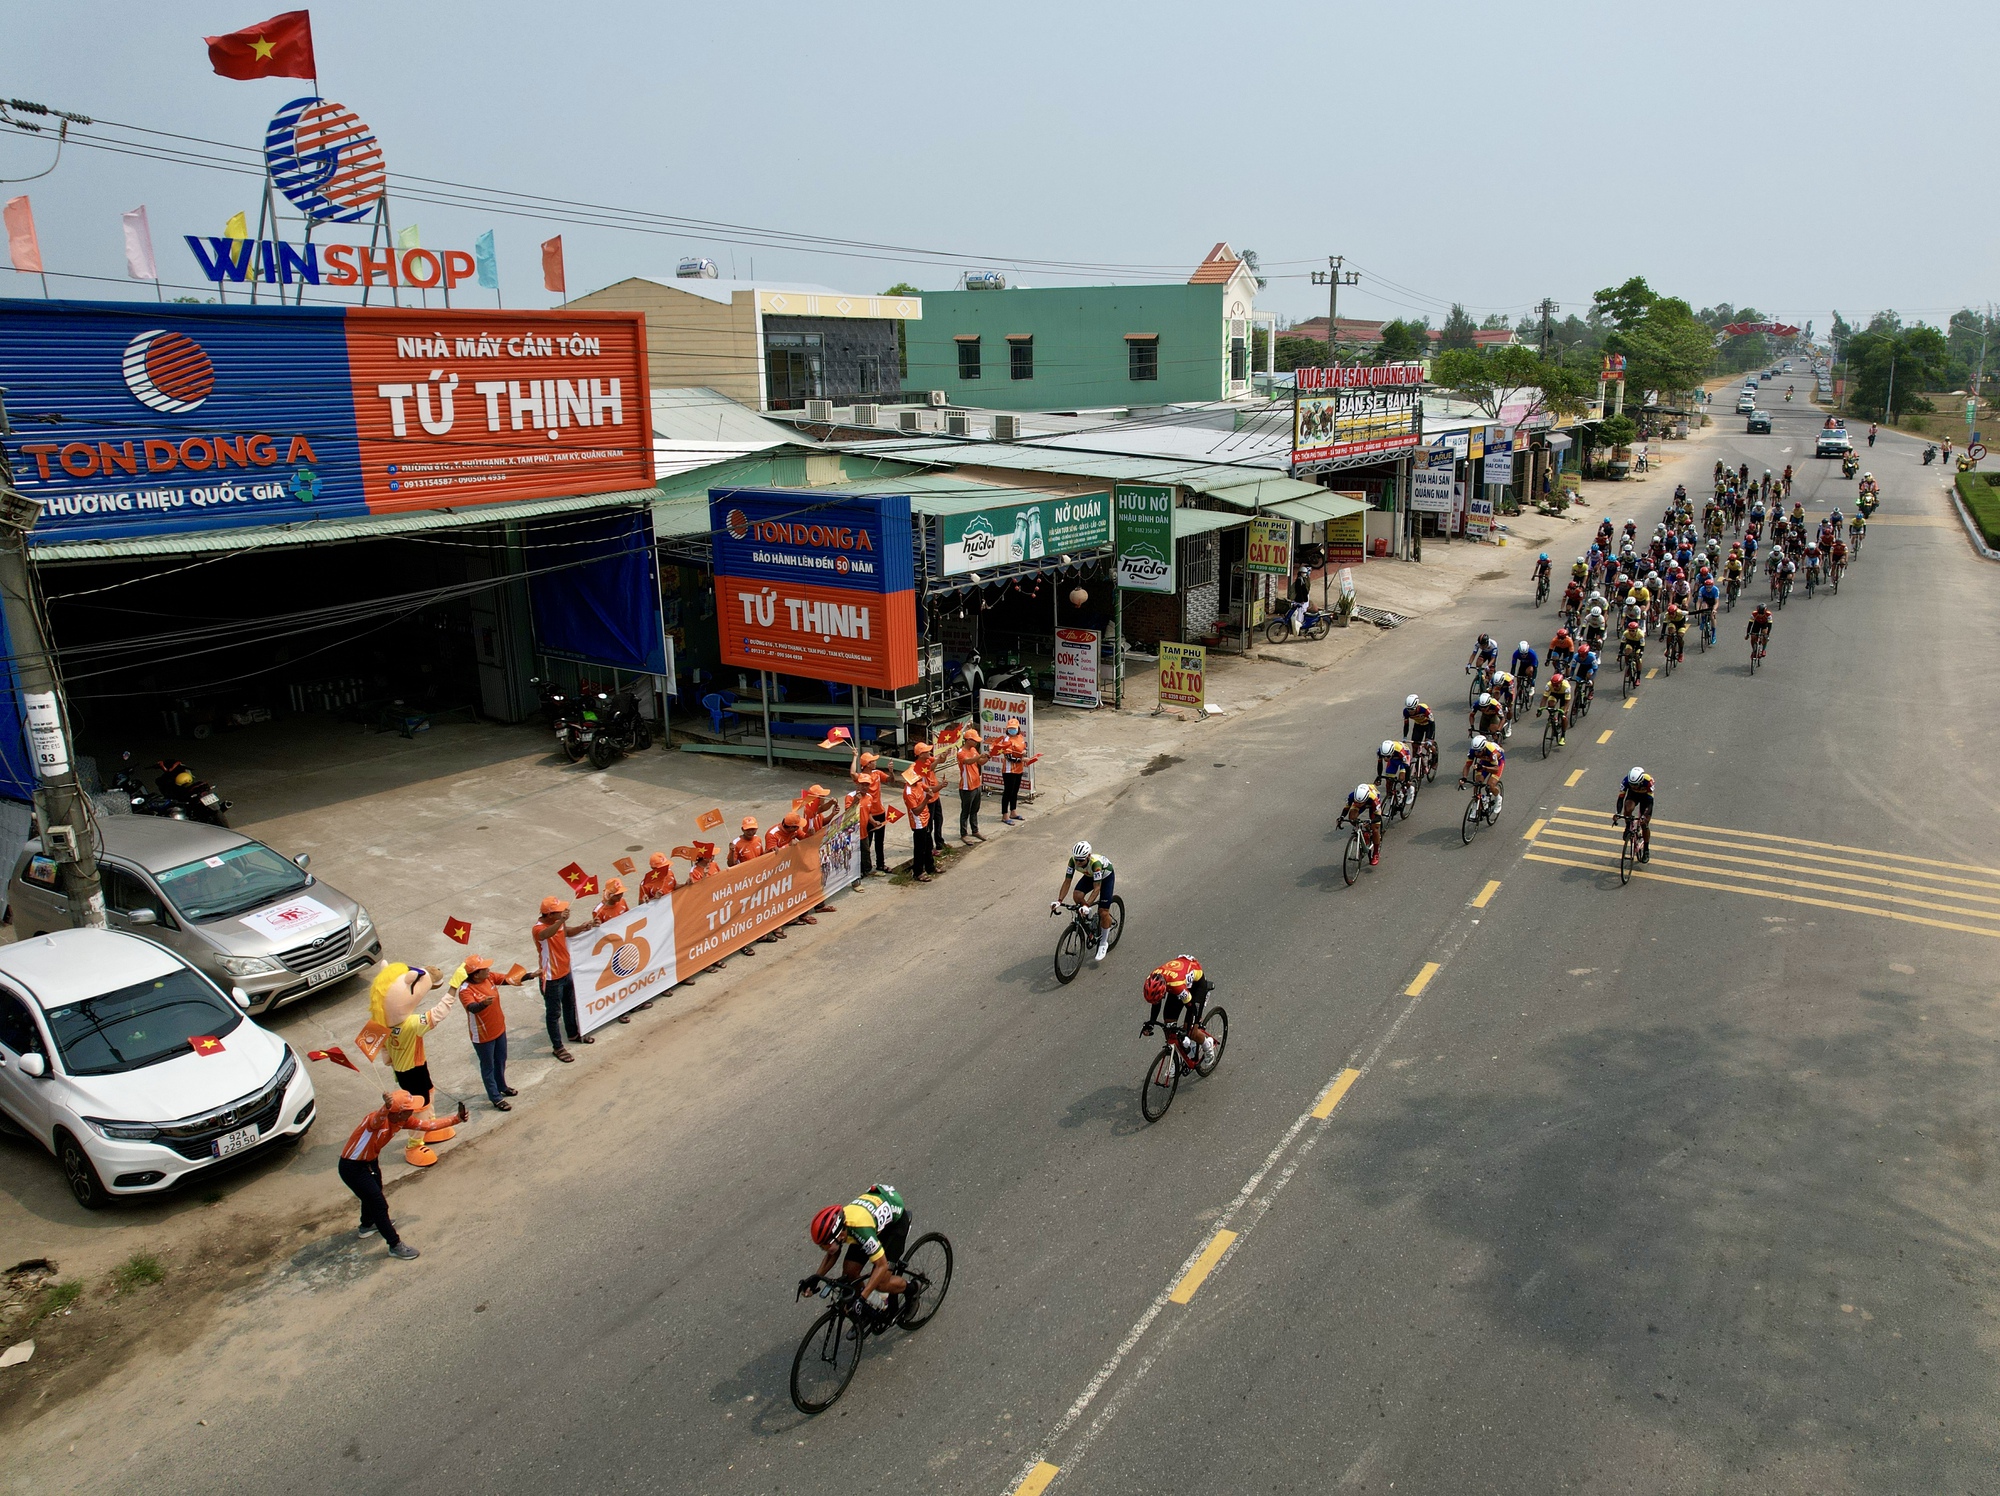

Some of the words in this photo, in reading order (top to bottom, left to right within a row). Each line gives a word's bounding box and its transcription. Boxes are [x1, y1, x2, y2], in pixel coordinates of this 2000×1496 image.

[183, 235, 476, 289] WINSHOP
[397, 332, 450, 358] NHÀ
[455, 332, 503, 357] MÁY
[506, 332, 552, 357] CÁN
[556, 332, 600, 356] TÔN
[1297, 366, 1323, 395] VỰA
[1325, 361, 1347, 389] HẢI
[1347, 361, 1371, 387] SẢN
[1371, 360, 1404, 388] QUẢNG
[1404, 366, 1426, 384] NAM
[378, 370, 459, 437] TỨ
[475, 378, 623, 440] THỊNH
[1340, 394, 1364, 413] BÁN
[1387, 391, 1408, 409] BÁN
[1409, 388, 1420, 406] LẺ
[20, 441, 138, 479] TON
[143, 434, 278, 472] DONG
[286, 433, 318, 464] A
[517, 456, 534, 464] TAM
[553, 453, 569, 461] TAM
[581, 450, 606, 460] QUẢNG
[607, 450, 624, 458] NAM
[1430, 452, 1453, 462] LARUE
[1415, 473, 1427, 486] VỰA
[1427, 472, 1438, 485] HẢI
[1438, 474, 1451, 485] SẢN
[40, 491, 132, 518] THƯƠNG
[137, 487, 185, 512] HIỆU
[191, 481, 248, 507] QUỐC
[252, 482, 286, 501] GIA
[1118, 492, 1146, 511] HỮU
[1149, 493, 1168, 512] NỞ
[1414, 487, 1435, 499] QUẢNG
[1435, 490, 1449, 499] NAM
[1055, 502, 1071, 524] NỞ
[1073, 499, 1101, 521] QUÁN
[1118, 513, 1137, 524] NHẬU
[1138, 513, 1154, 523] BÌNH
[1155, 515, 1169, 524] DÂN
[1471, 501, 1481, 513] GỎI
[1482, 504, 1491, 514] CÁ
[751, 520, 793, 544] TON
[794, 524, 853, 550] DONG
[856, 529, 873, 551] A
[1253, 520, 1269, 528] TAM
[1271, 521, 1287, 530] PHÚ
[963, 533, 996, 555] huda
[752, 549, 770, 563] BẢO
[771, 552, 797, 566] HÀNH
[797, 554, 814, 567] LÊN
[815, 555, 834, 569] ĐẾN
[836, 560, 848, 571] 50
[851, 560, 874, 573] NĂM
[1121, 556, 1168, 576] huda
[738, 587, 777, 627] TỨ
[784, 598, 870, 643] THỊNH
[1057, 651, 1075, 666] CƠM
[1163, 646, 1181, 655] TAM
[1183, 648, 1201, 658] PHÚ
[983, 697, 1007, 712] HỮU
[1008, 699, 1027, 714] NỞ
[994, 713, 1006, 722] BIA
[41, 753, 56, 763] 93
[712, 884, 733, 902] NHÀ
[735, 876, 754, 893] MÁY
[706, 900, 733, 931] TỨ
[740, 874, 793, 914] THỊNH
[689, 936, 719, 960] CHÀO
[721, 918, 753, 943] MỪNG
[755, 902, 784, 925] ĐOÀN
[787, 891, 808, 909] ĐUA
[592, 917, 651, 991] 25
[309, 962, 347, 986] 43A-120.45
[586, 993, 616, 1015] TON
[618, 972, 656, 1005] DONG
[656, 967, 667, 979] A
[224, 1134, 256, 1153] 229.50
[229, 1130, 247, 1143] 92A
